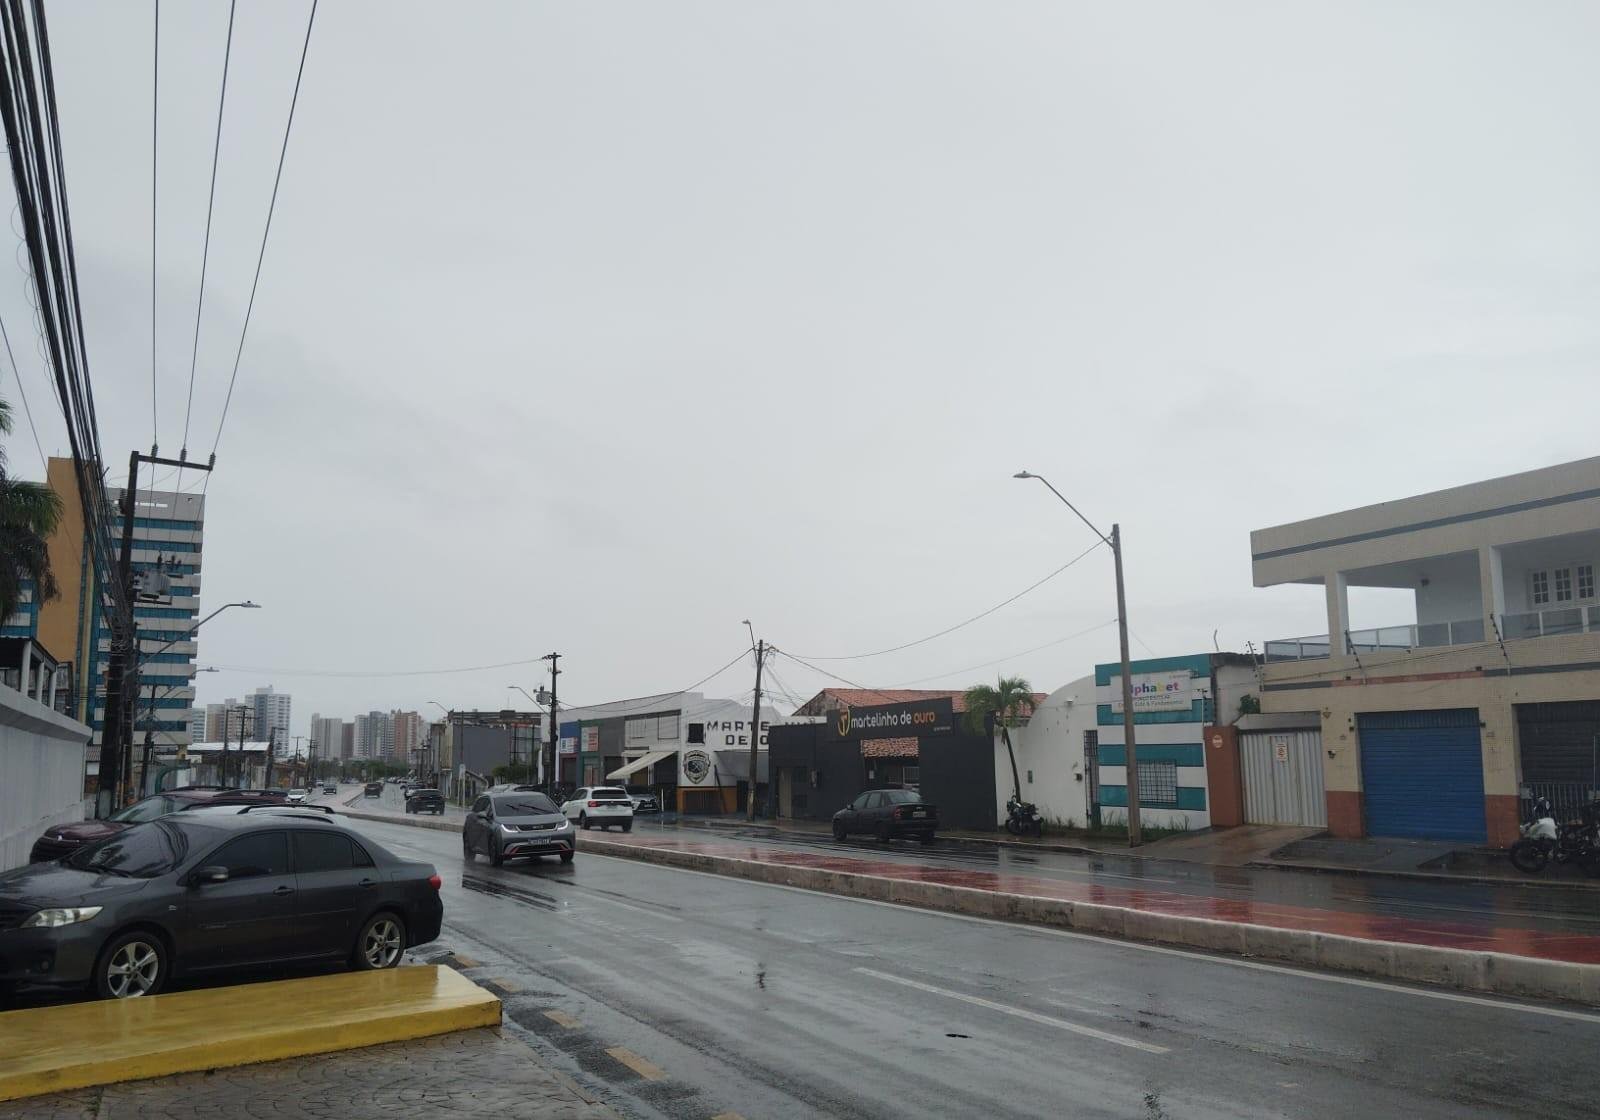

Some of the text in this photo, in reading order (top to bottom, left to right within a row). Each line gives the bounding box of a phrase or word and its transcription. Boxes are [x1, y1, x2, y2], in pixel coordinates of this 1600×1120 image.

[851, 710, 935, 729] martelinho de ouro
